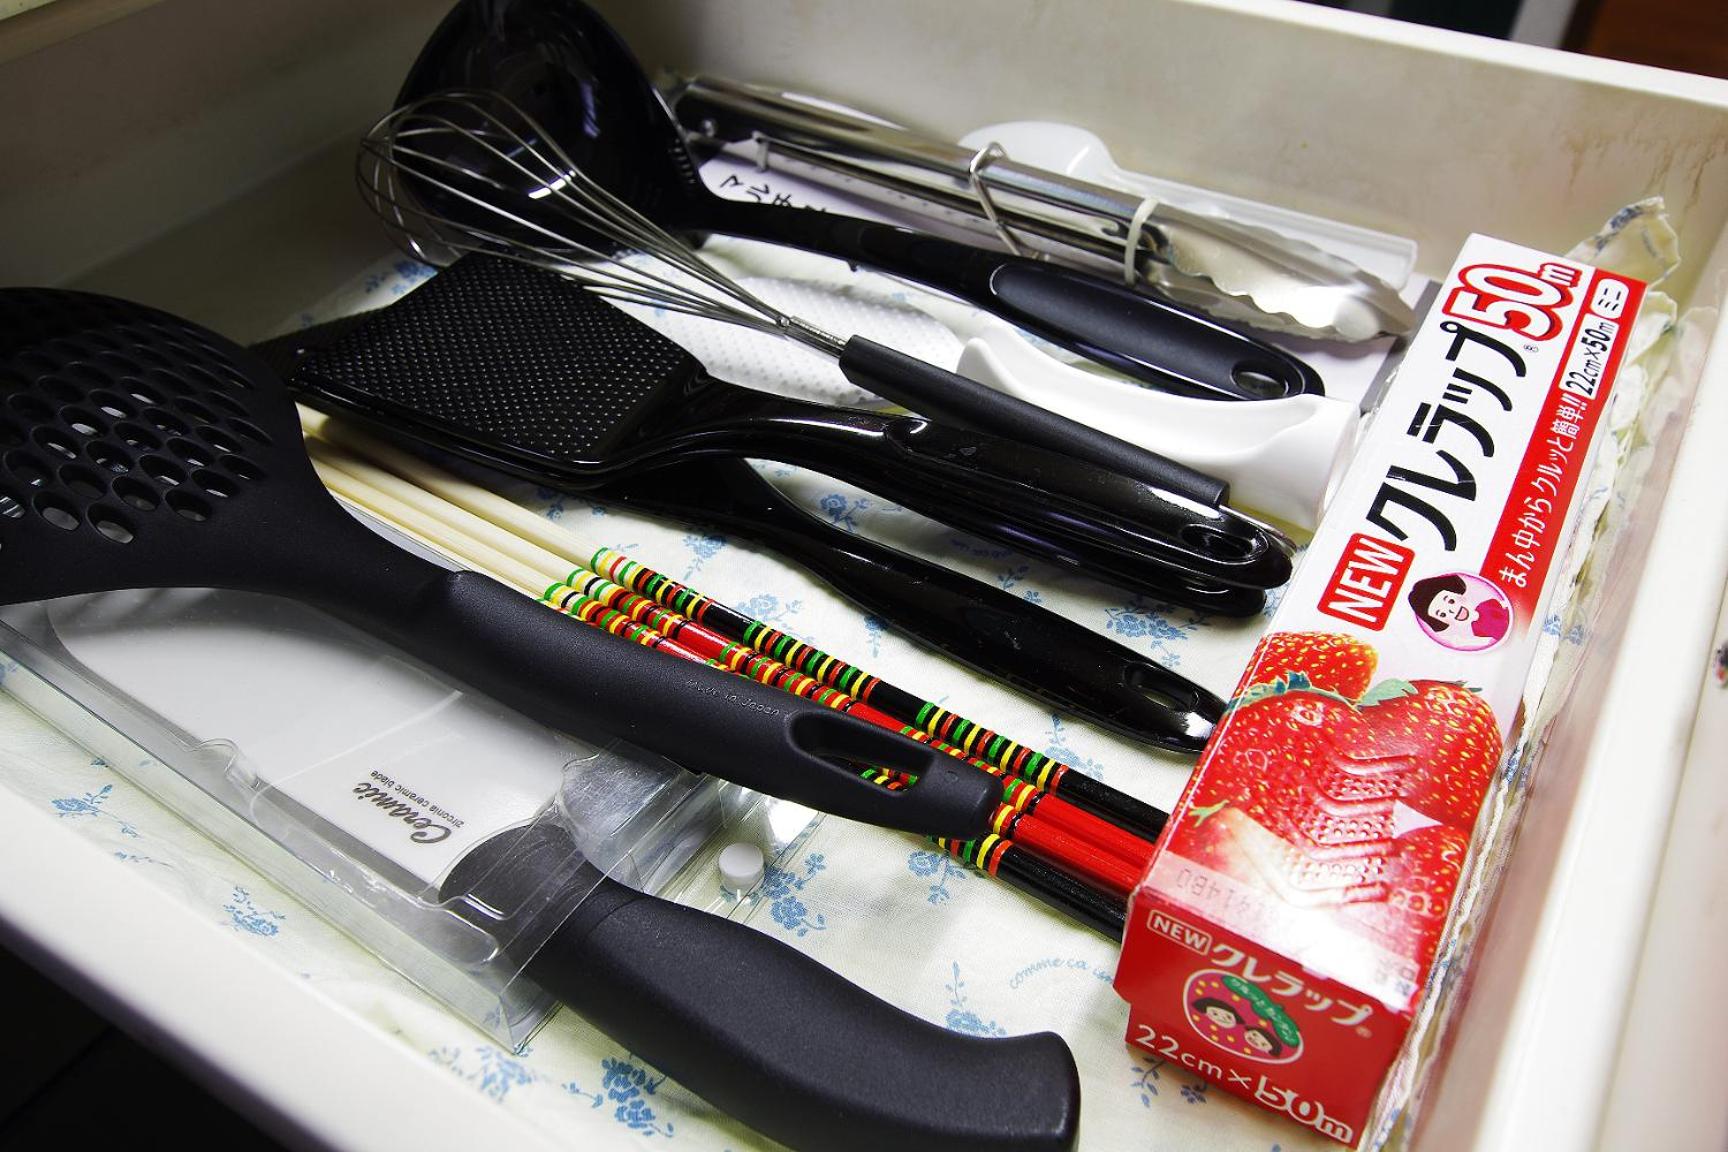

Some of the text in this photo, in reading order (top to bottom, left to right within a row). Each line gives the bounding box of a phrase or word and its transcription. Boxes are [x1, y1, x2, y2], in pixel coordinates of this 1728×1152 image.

[719, 173, 826, 213] マルチ
[1598, 287, 1623, 312] ミニ
[1328, 262, 1584, 624] NEW クレラップ 50m
[353, 782, 452, 844] Ceramic
[370, 770, 465, 828] zirconia ceramic blade
[1152, 915, 1208, 950] NEW
[1210, 943, 1374, 1027] クレラップ
